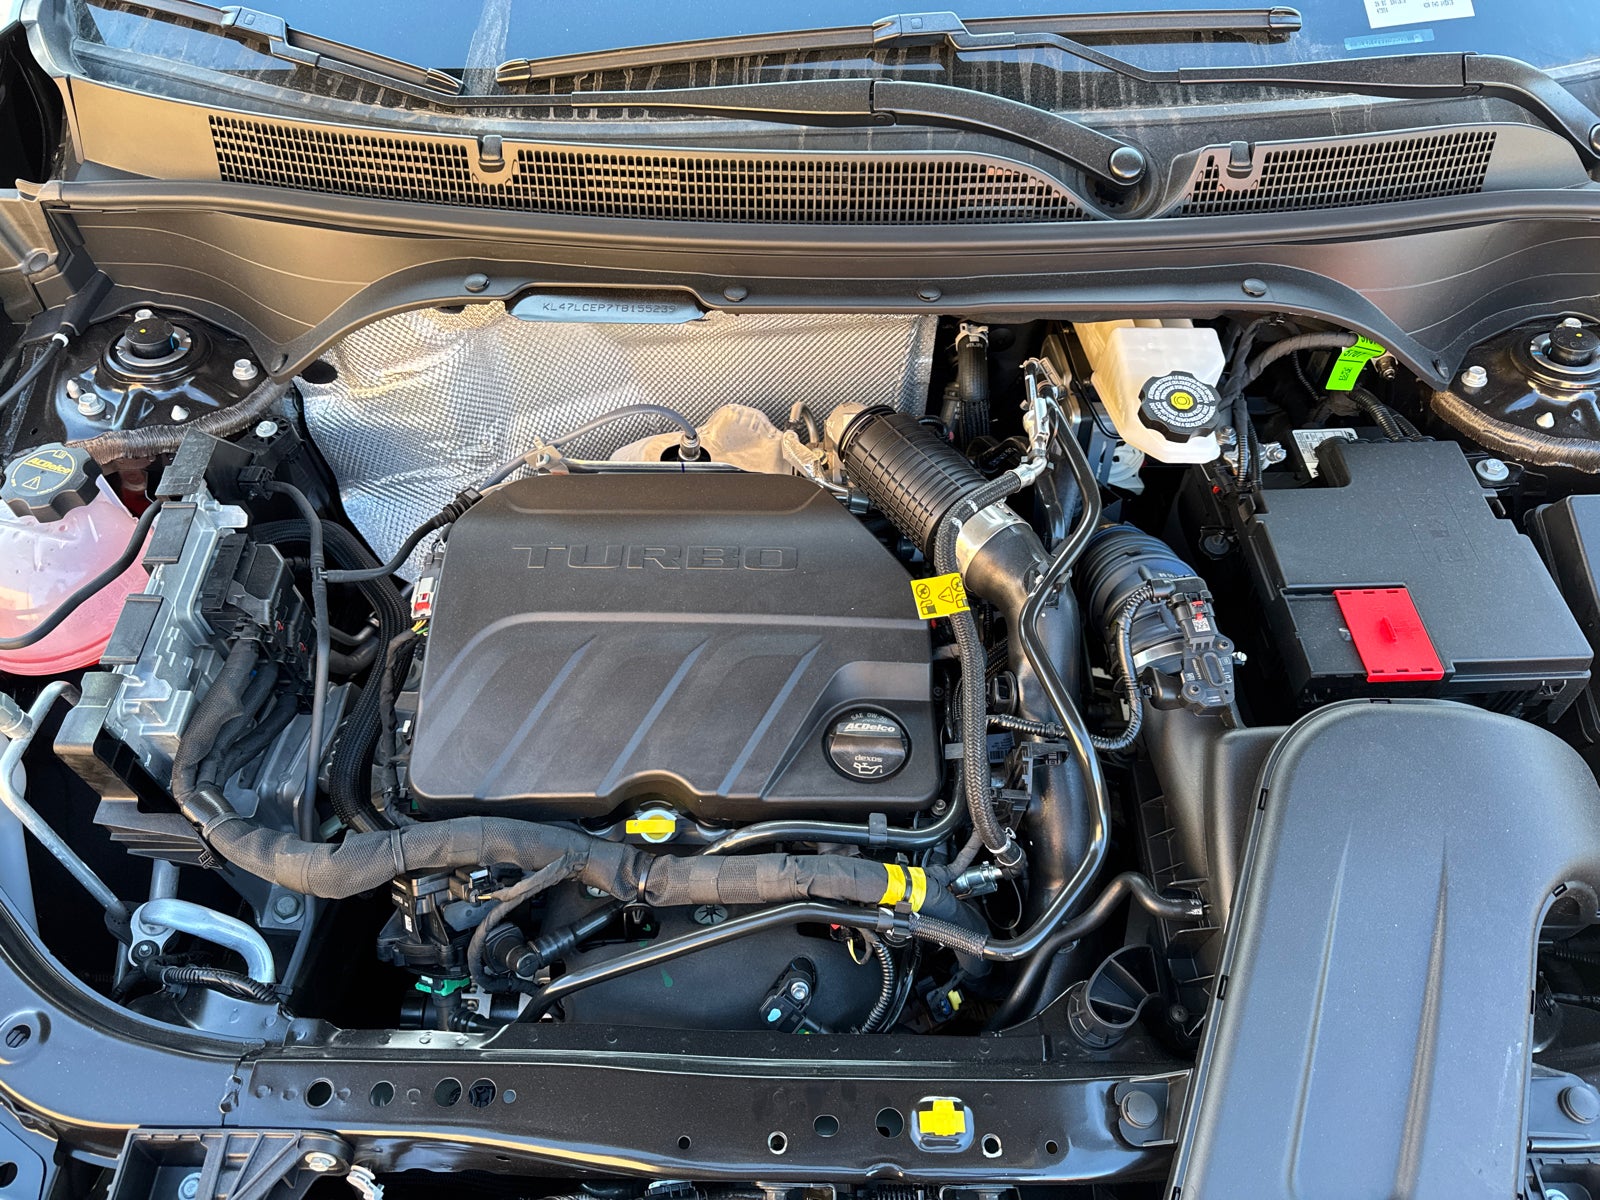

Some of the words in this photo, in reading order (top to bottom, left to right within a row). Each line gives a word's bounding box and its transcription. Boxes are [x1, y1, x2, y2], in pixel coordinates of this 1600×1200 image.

[511, 544, 799, 571] TURBO
[850, 712, 864, 721] SAE
[844, 722, 896, 733] ACDelco
[854, 754, 883, 763] dexos
